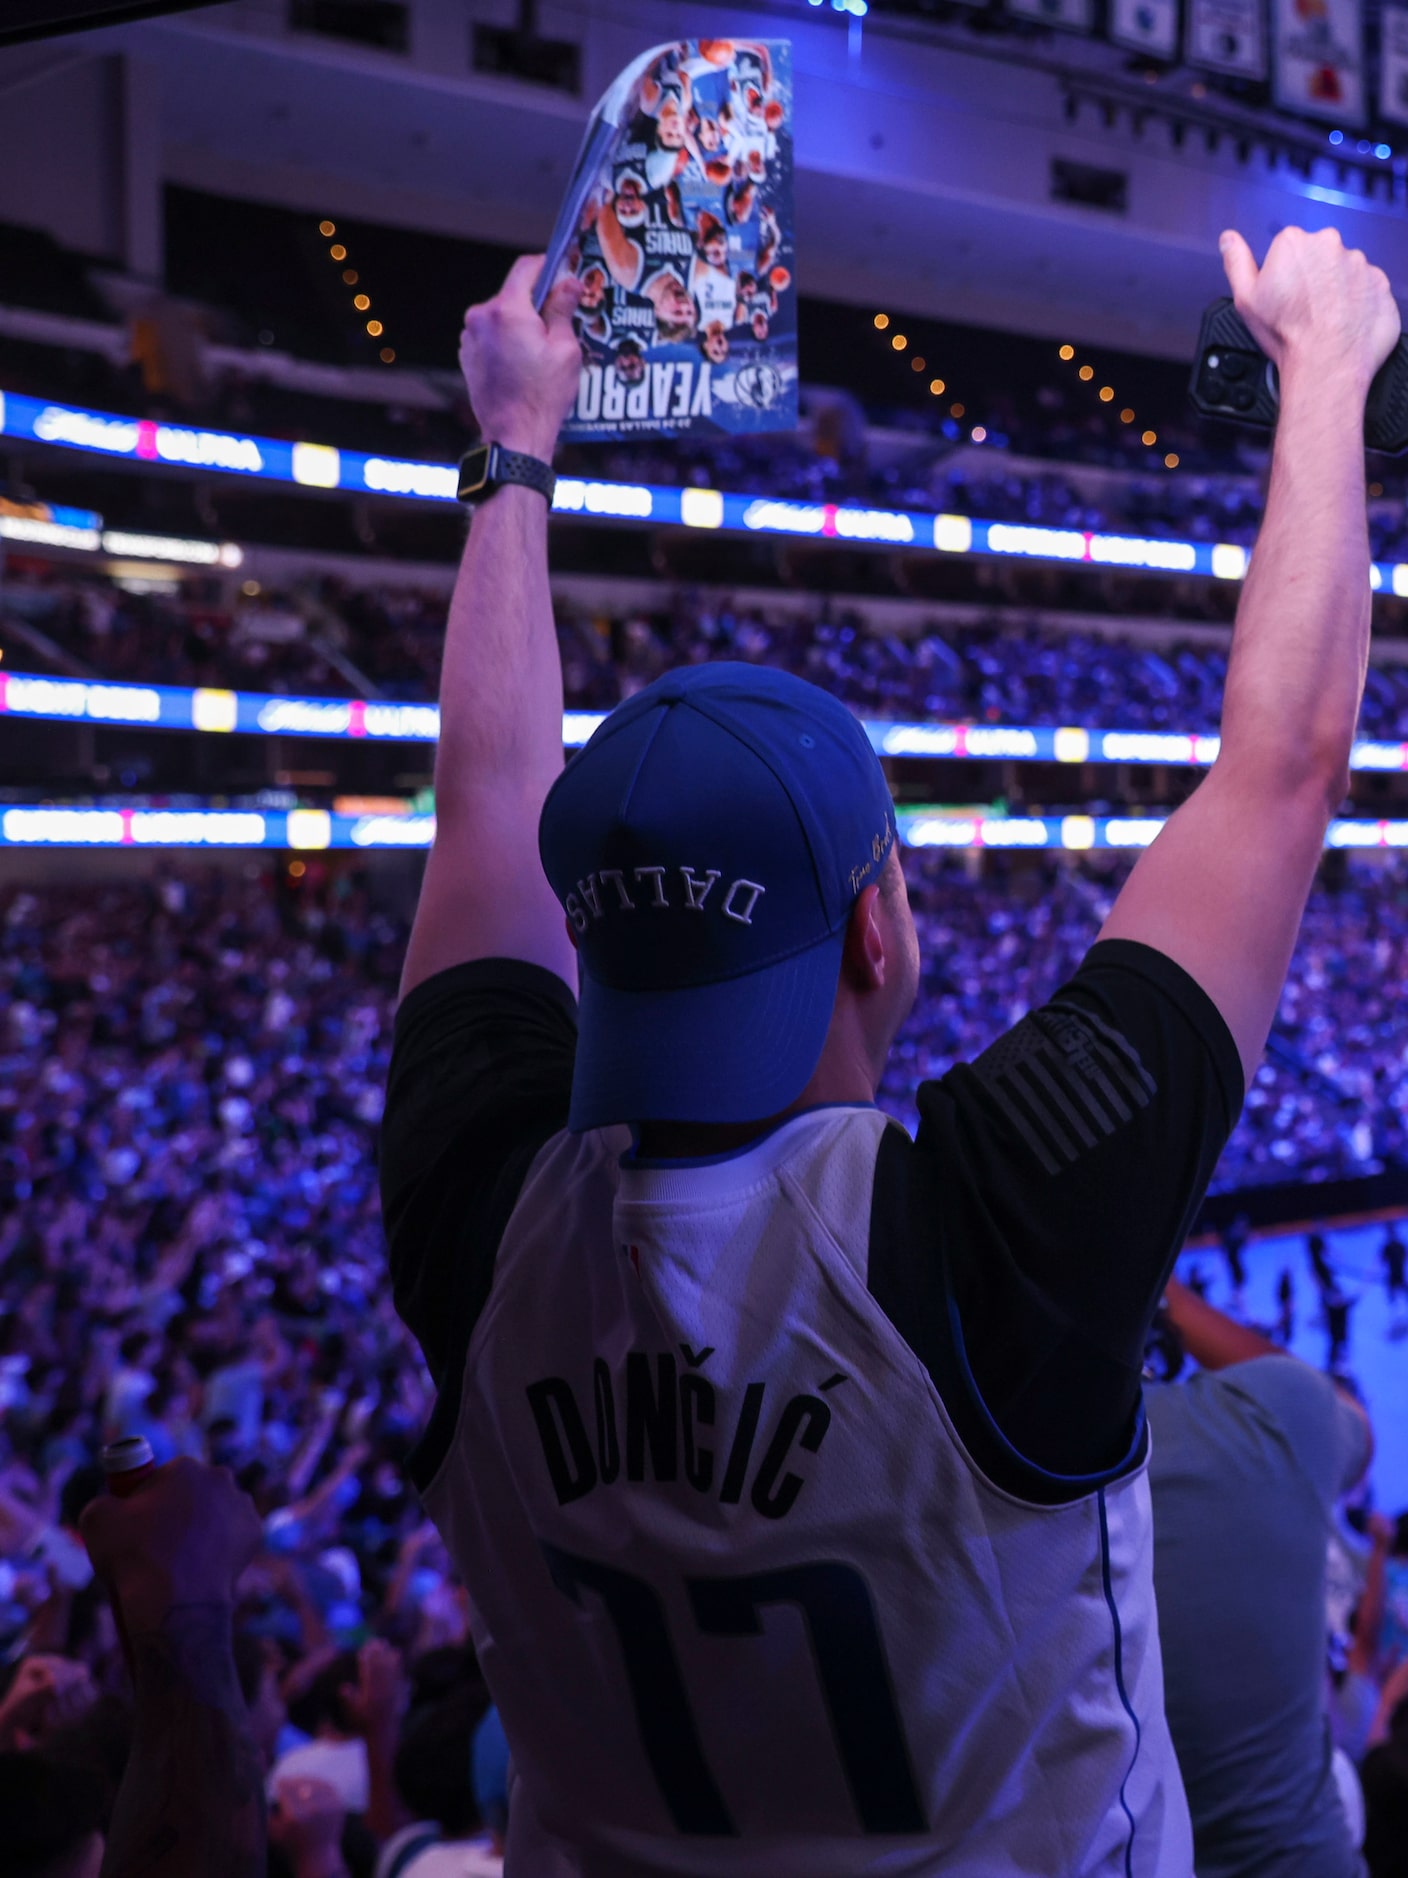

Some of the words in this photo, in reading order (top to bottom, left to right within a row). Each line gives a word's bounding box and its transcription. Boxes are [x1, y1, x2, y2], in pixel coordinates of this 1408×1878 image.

[568, 362, 712, 420] YEARBO
[565, 865, 765, 933] DALLAS
[526, 1343, 848, 1520] DONČIĆ
[540, 1540, 932, 1836] 77
